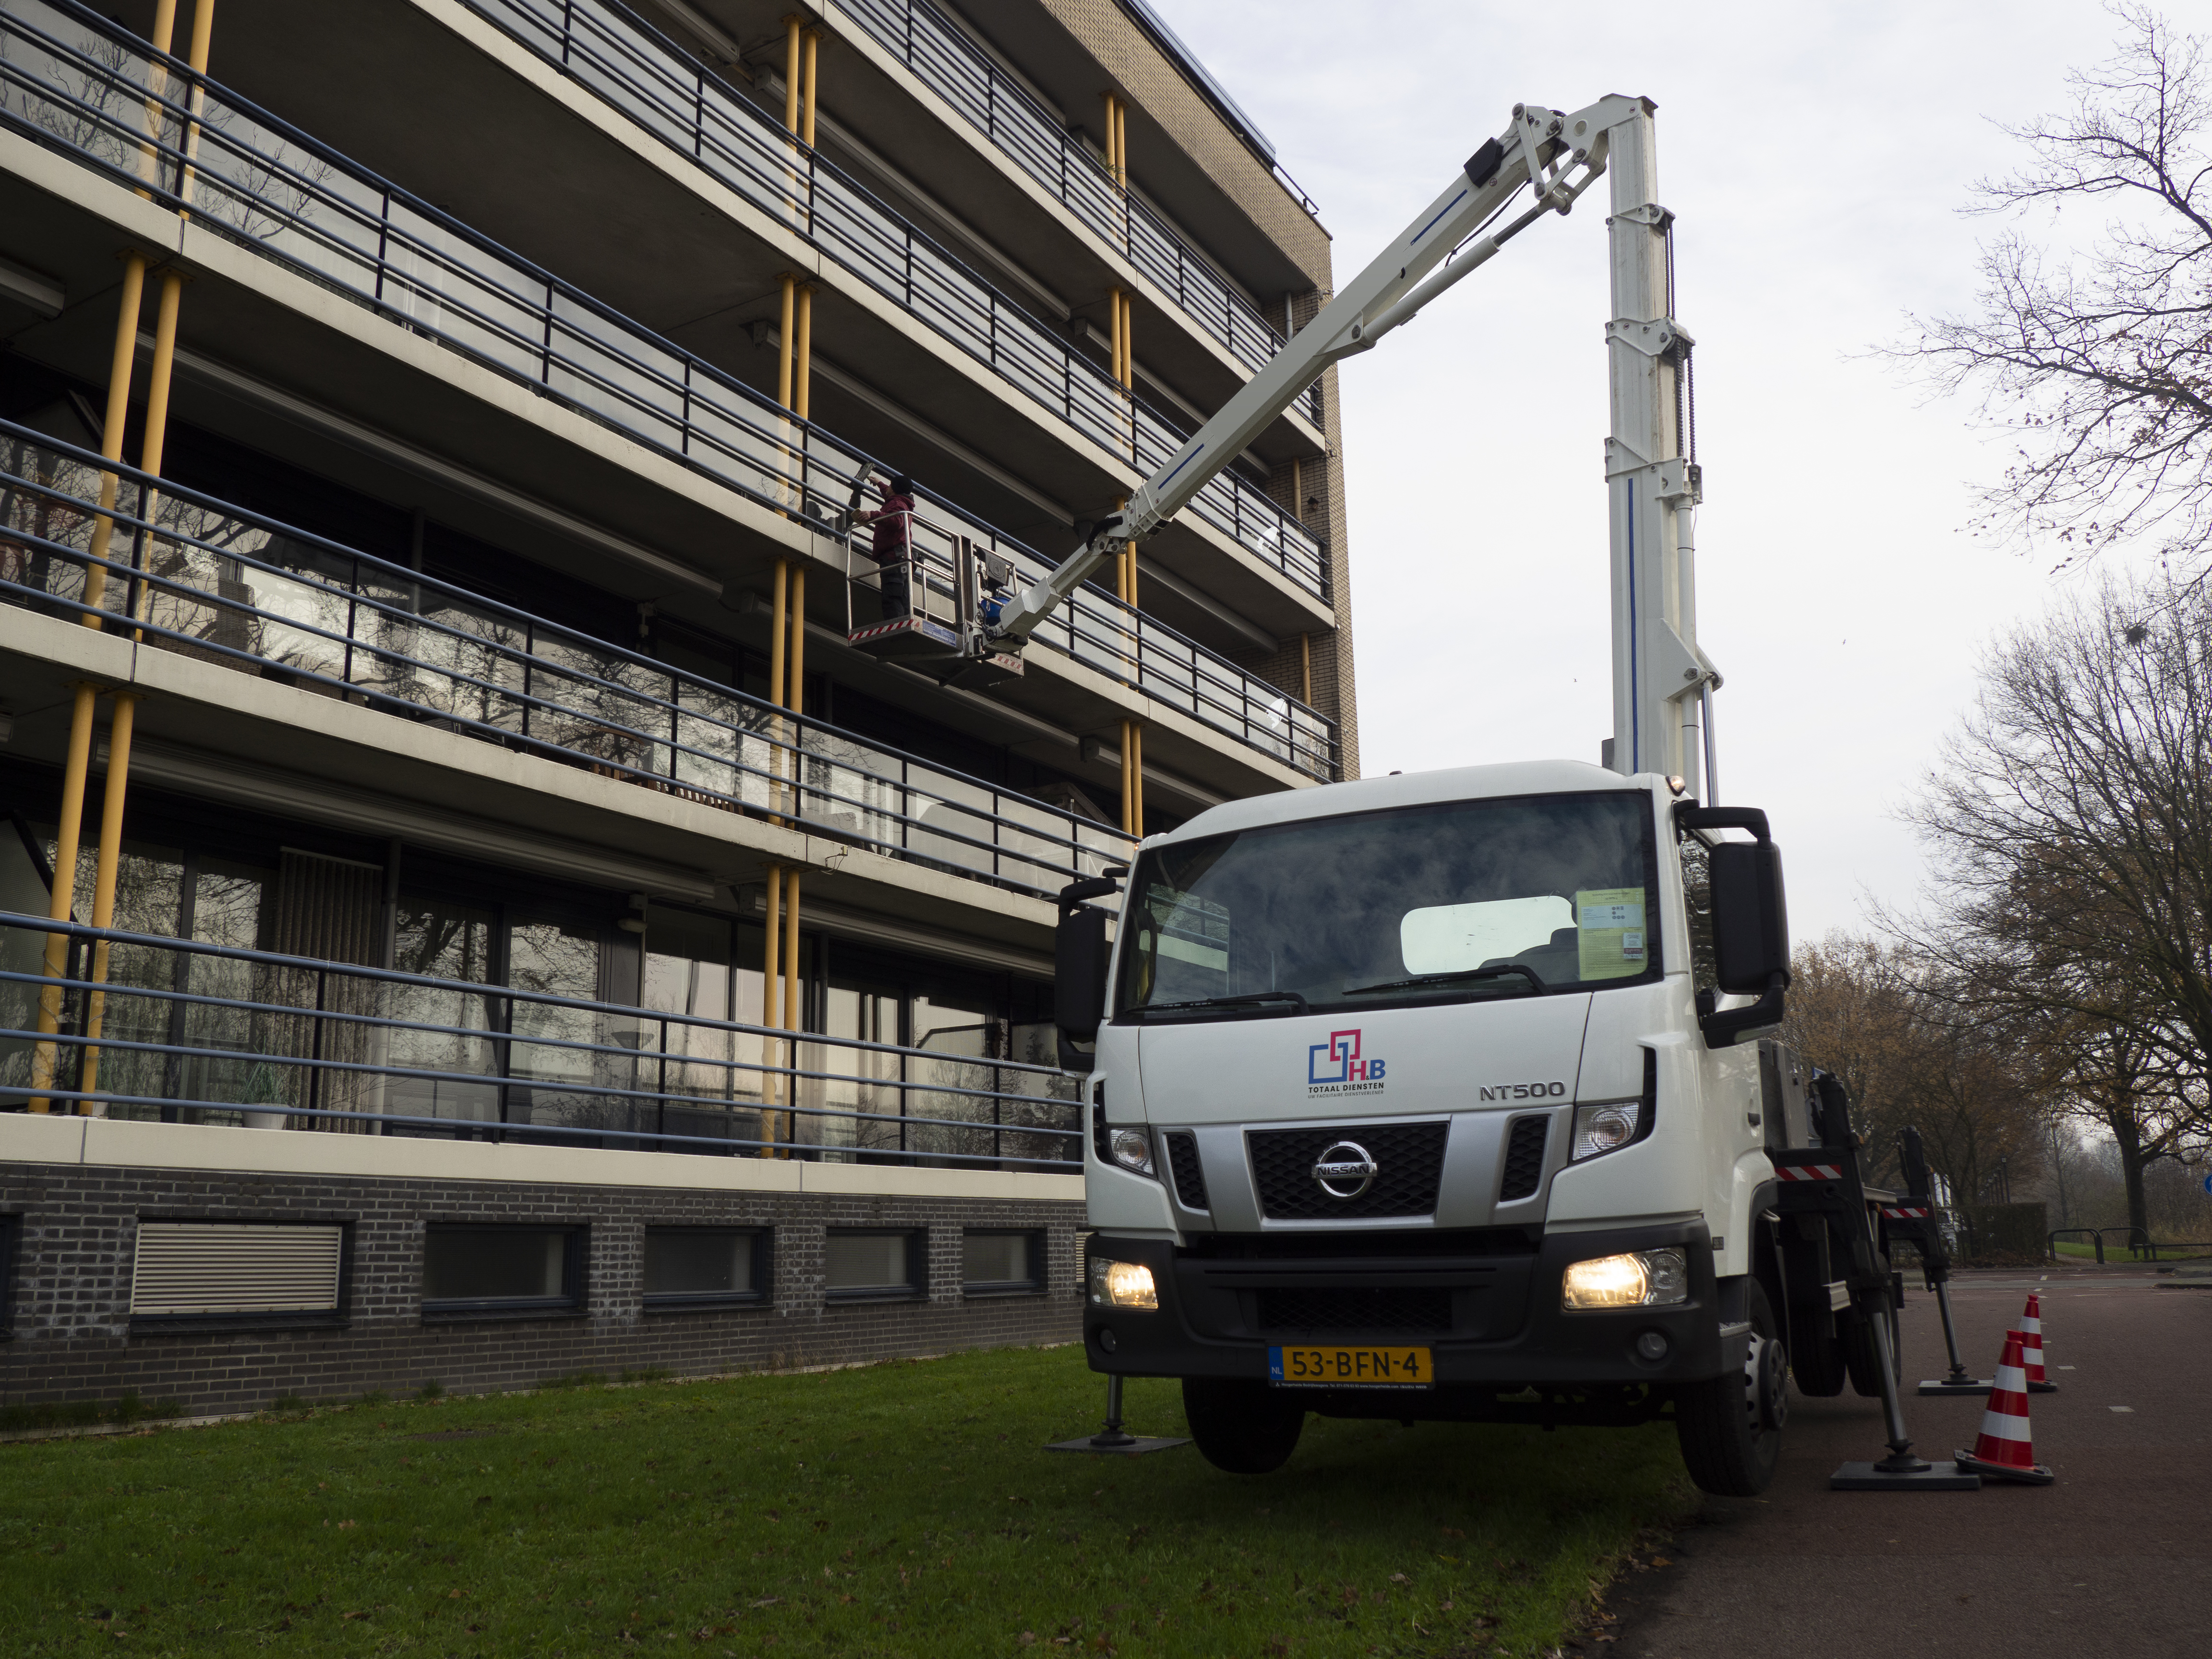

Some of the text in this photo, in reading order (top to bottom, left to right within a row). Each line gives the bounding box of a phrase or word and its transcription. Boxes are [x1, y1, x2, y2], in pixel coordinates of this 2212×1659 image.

[1343, 1082, 1384, 1091] DIENSTEN
[1479, 1081, 1565, 1101] NT500
[1317, 1166, 1370, 1176] NISSAN
[1292, 1351, 1419, 1377] 53-BFN-4
[1271, 1366, 1283, 1375] NL
